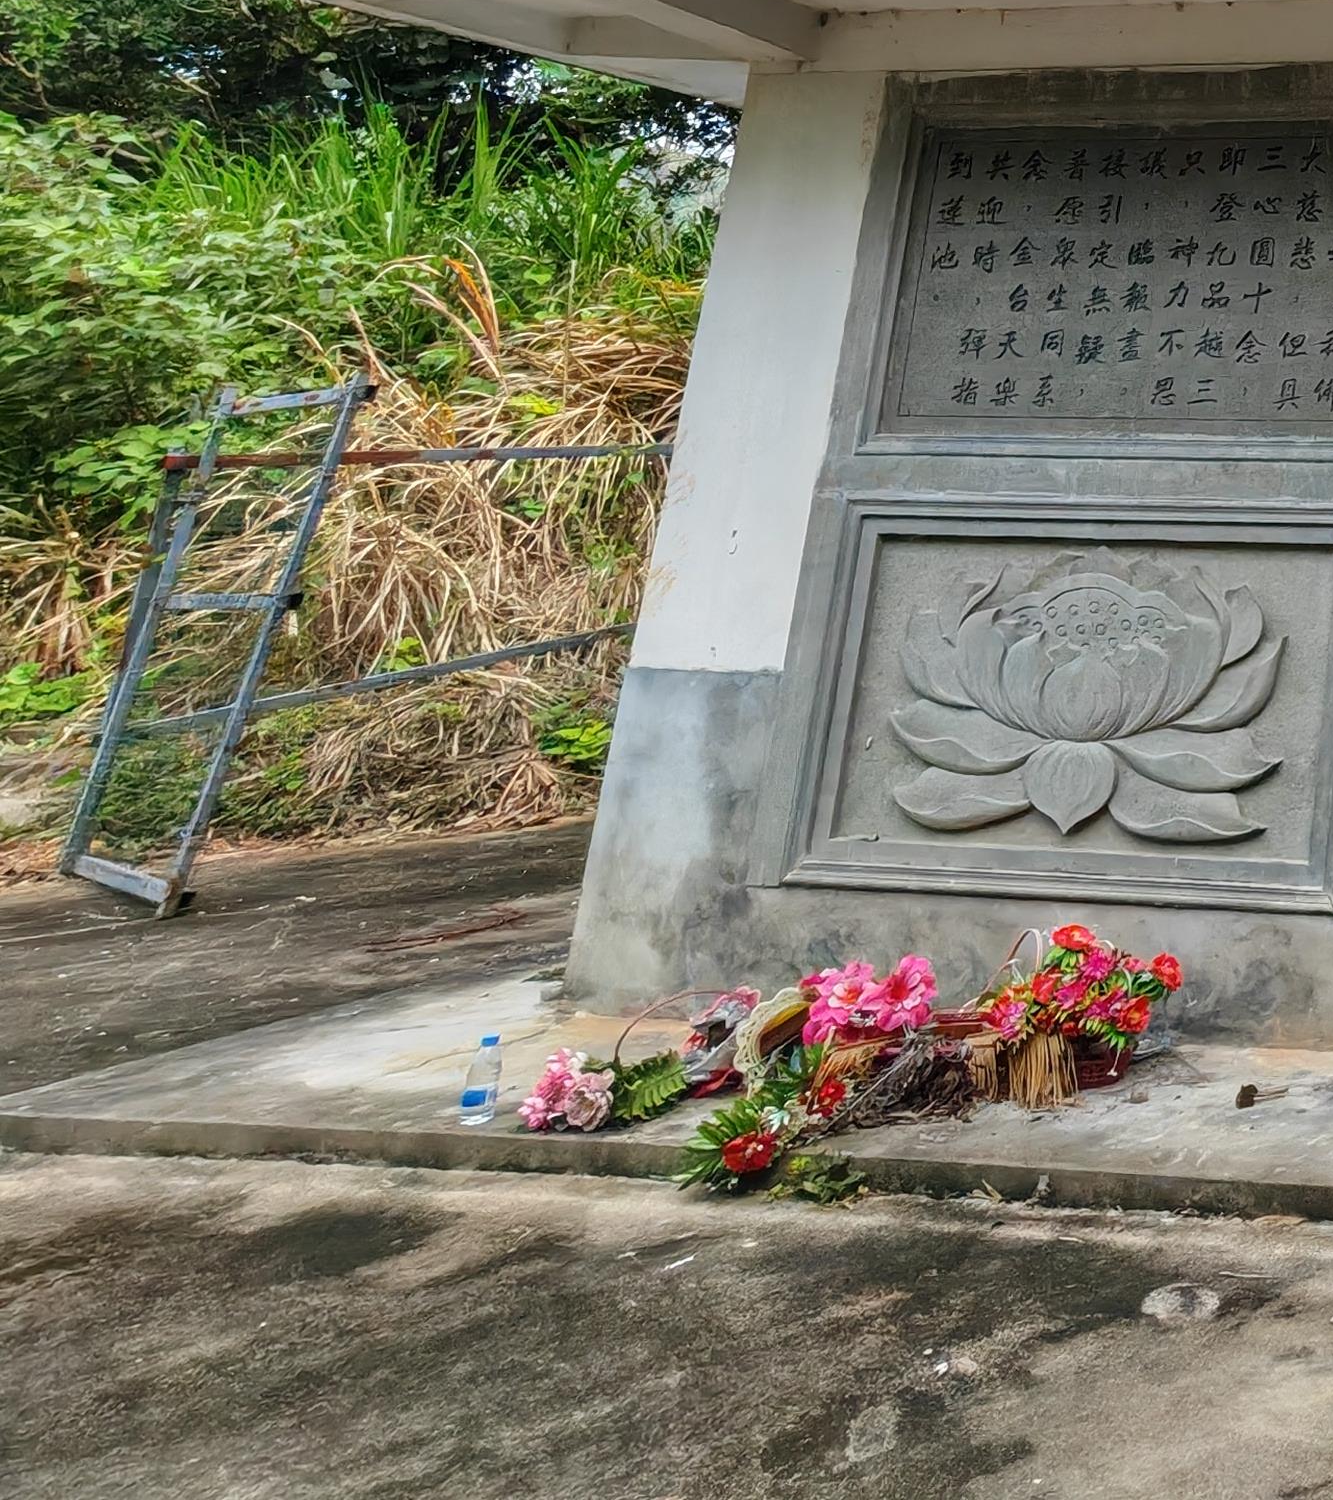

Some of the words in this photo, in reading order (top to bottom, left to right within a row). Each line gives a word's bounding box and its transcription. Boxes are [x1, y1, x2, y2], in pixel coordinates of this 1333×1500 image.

[1187, 145, 1245, 405] 即登九品越三
